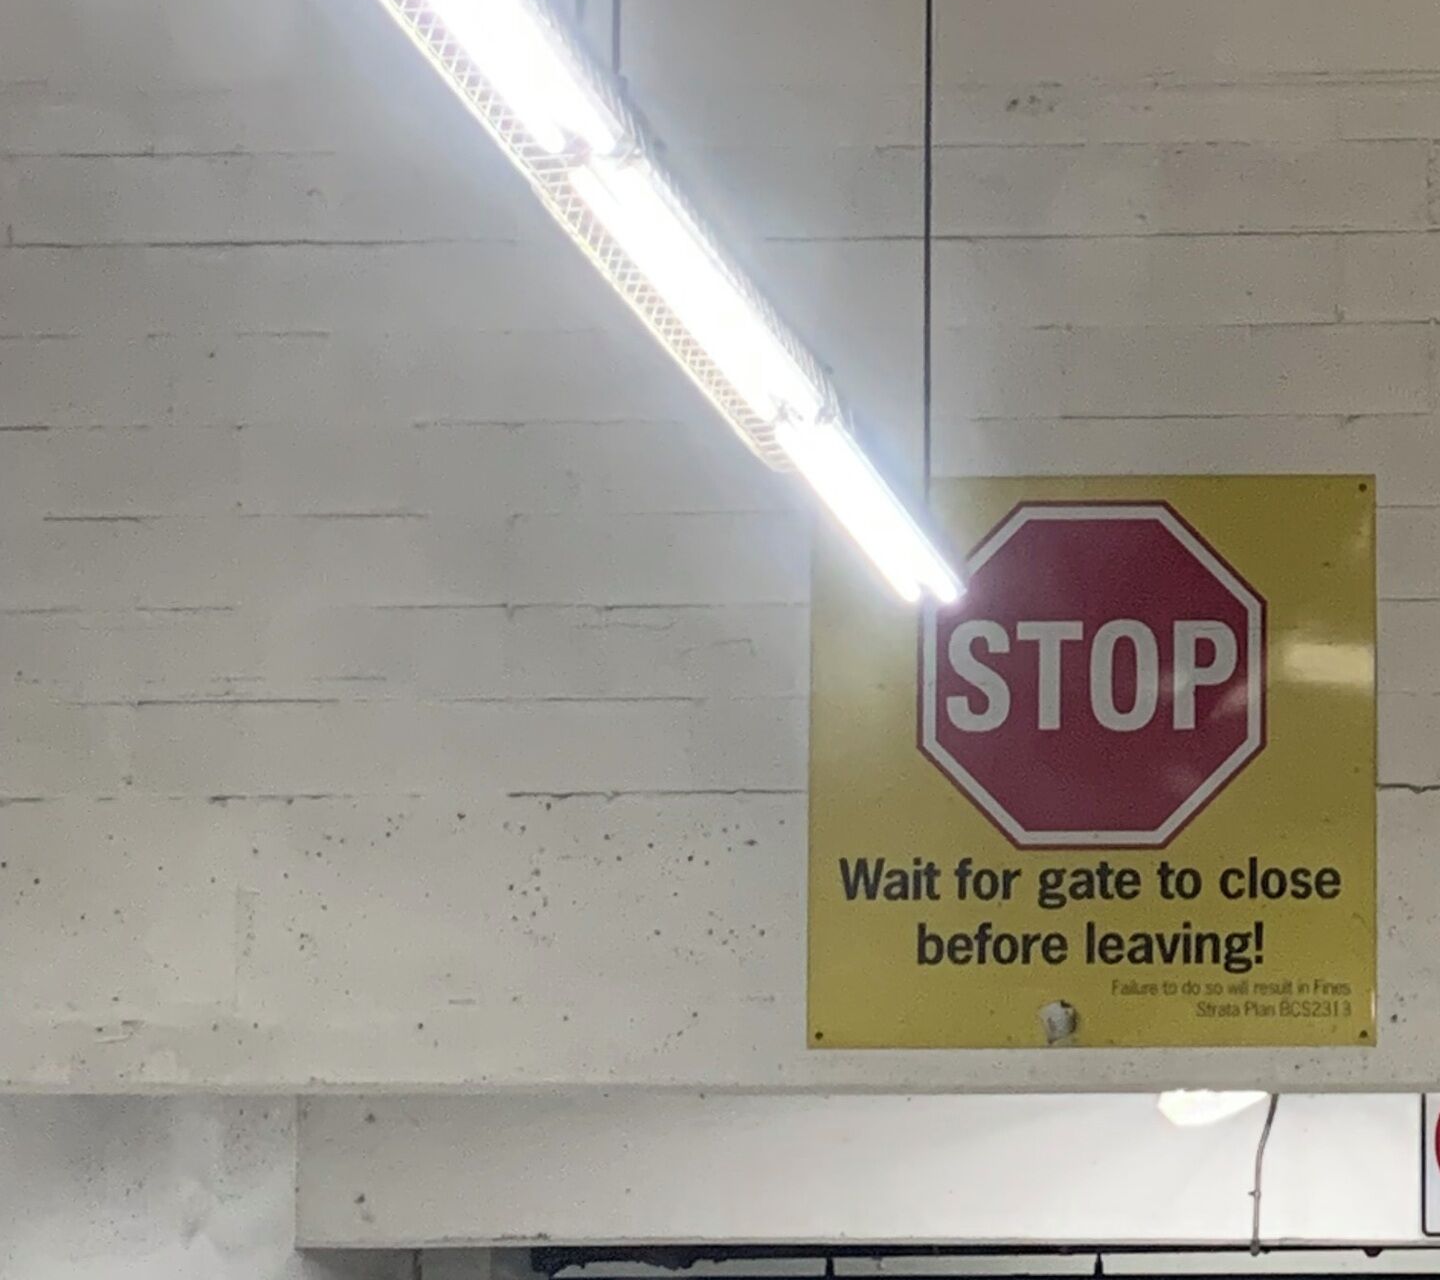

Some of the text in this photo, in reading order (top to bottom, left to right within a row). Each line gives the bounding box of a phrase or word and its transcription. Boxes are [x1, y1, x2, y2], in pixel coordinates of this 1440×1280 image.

[945, 618, 1239, 733] STOP
[839, 858, 1341, 908] Wait for gate to close
[917, 922, 1264, 973] before leaving!
[1111, 979, 1351, 995] Failure to do so will result in Fines
[1196, 1001, 1240, 1017] Strata
[1244, 1001, 1276, 1017] Plan
